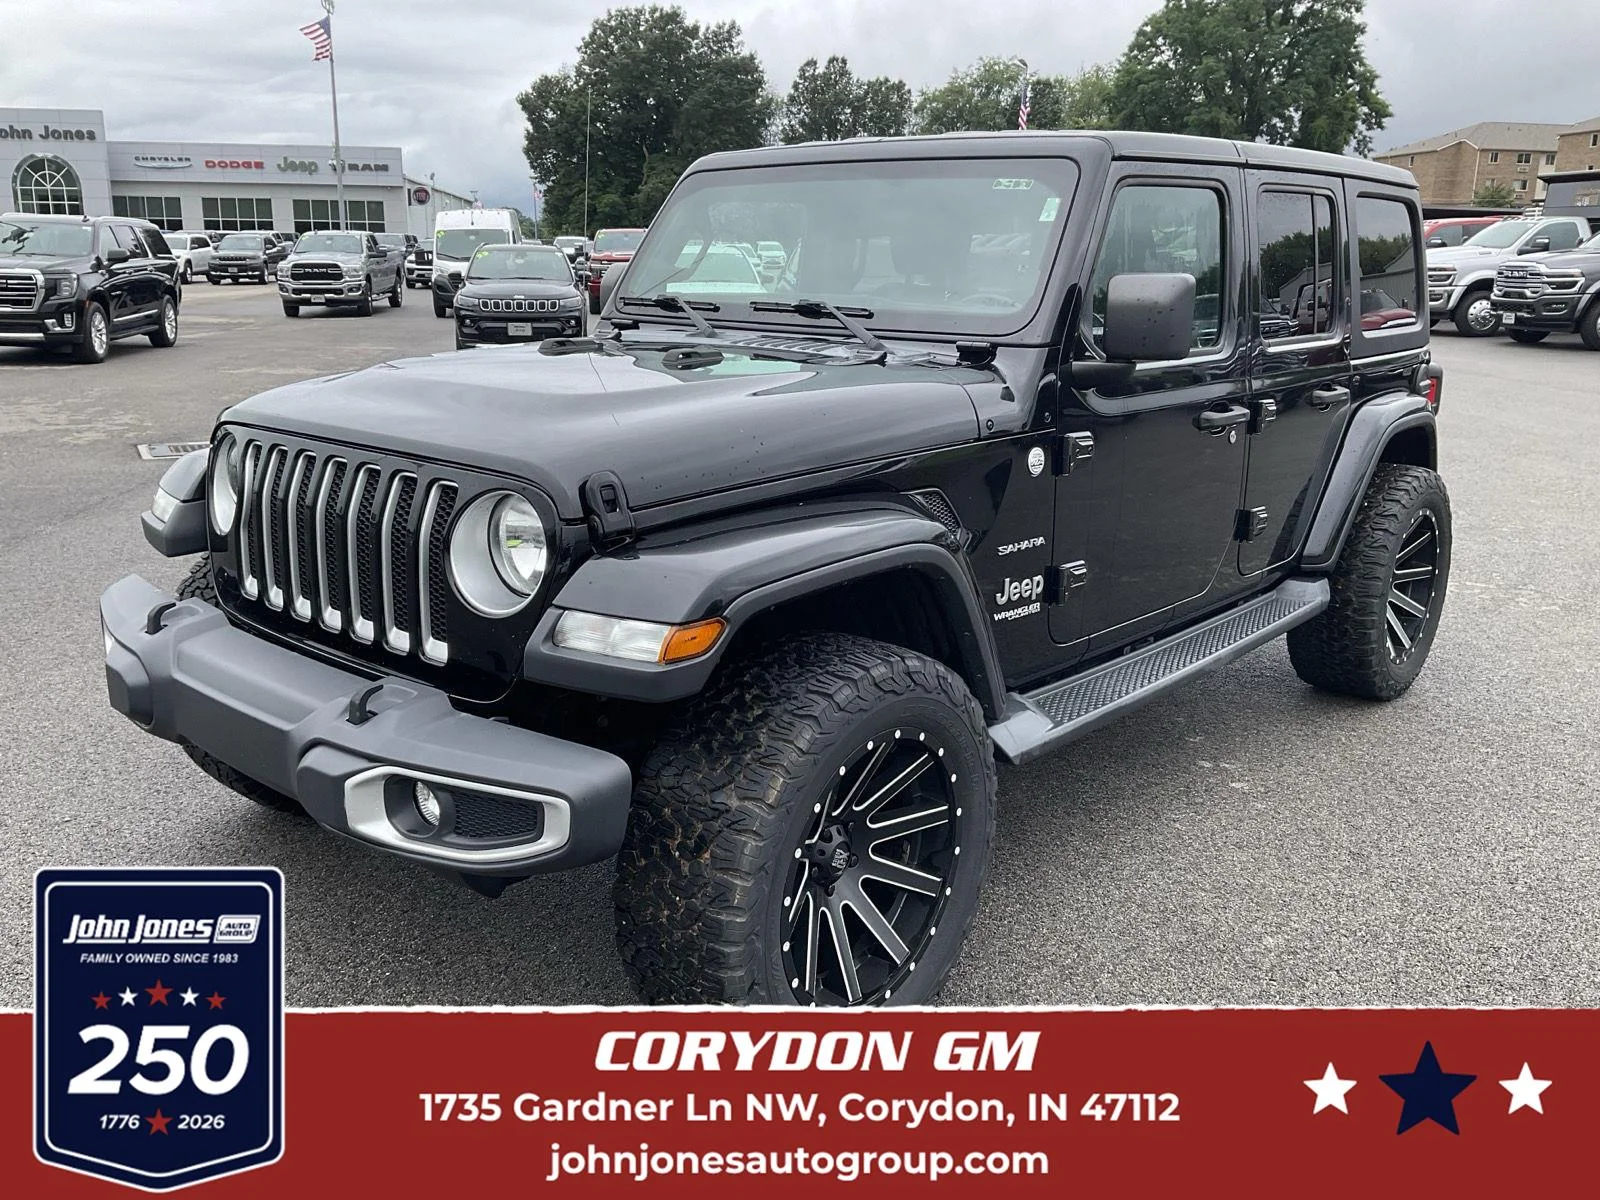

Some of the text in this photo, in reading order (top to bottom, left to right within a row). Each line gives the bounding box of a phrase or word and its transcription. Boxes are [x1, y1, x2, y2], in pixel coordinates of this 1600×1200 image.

[39, 125, 96, 141] Jones
[205, 160, 265, 169] DODGE
[276, 156, 318, 176] Jeep
[347, 163, 389, 172] RAM
[1503, 270, 1528, 278] RAM
[997, 536, 1046, 556] SAHARA
[995, 574, 1044, 605] Jeep
[993, 602, 1041, 621] WRANGLER
